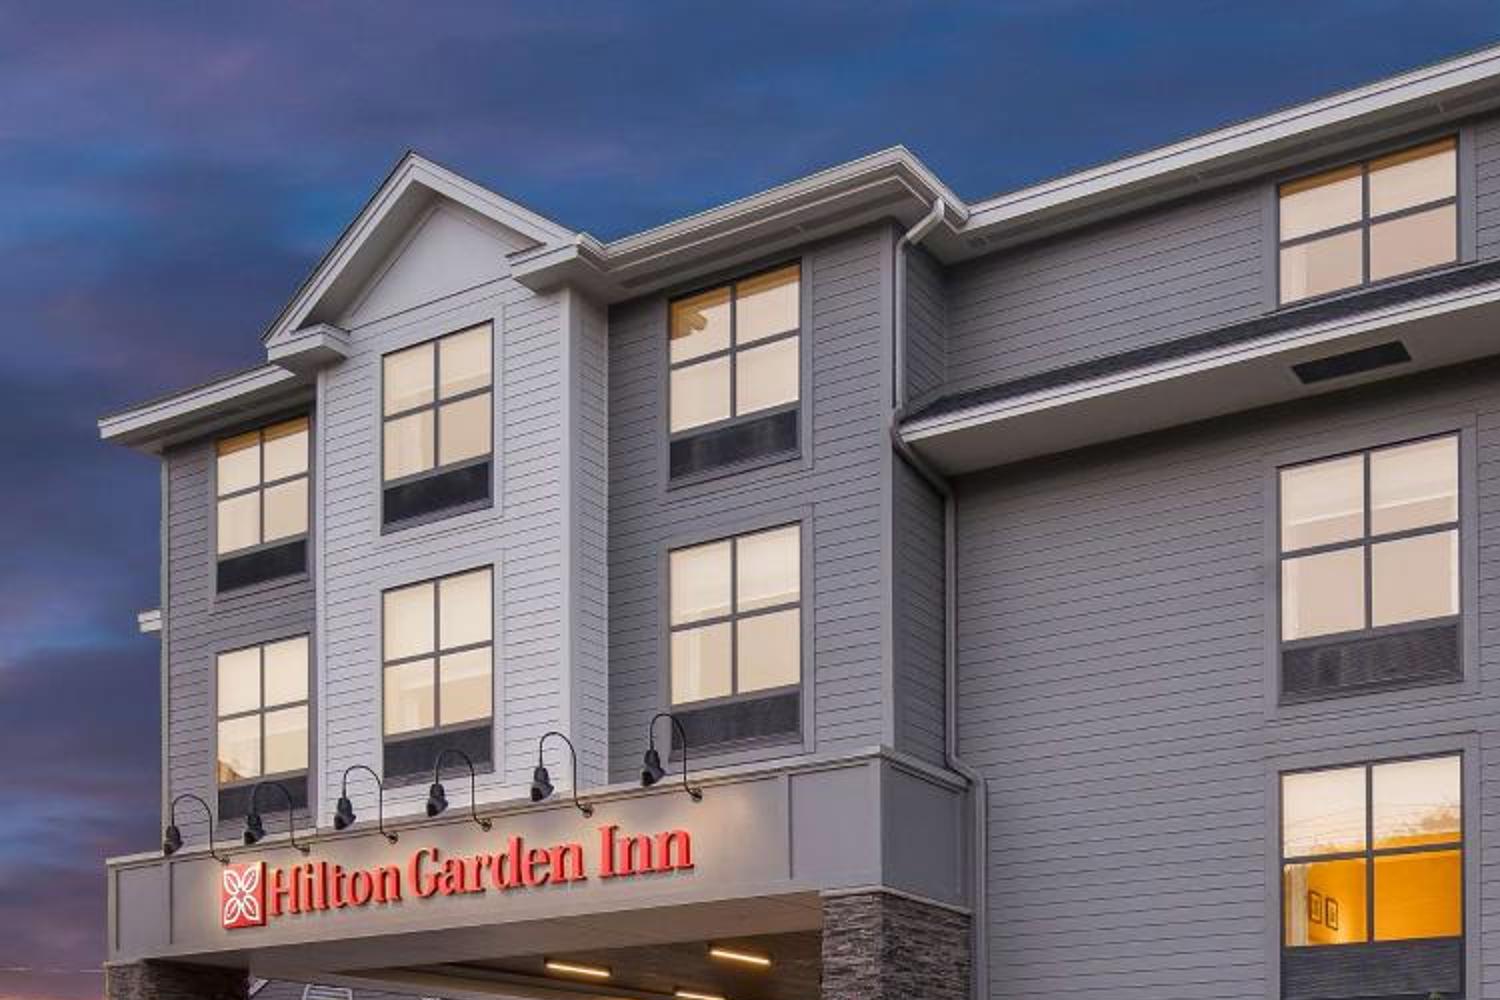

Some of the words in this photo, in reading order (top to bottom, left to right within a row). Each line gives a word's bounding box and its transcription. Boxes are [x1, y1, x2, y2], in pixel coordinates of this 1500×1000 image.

[269, 861, 402, 917] Hilton
[409, 836, 585, 898] Garden
[599, 824, 694, 878] Inn
